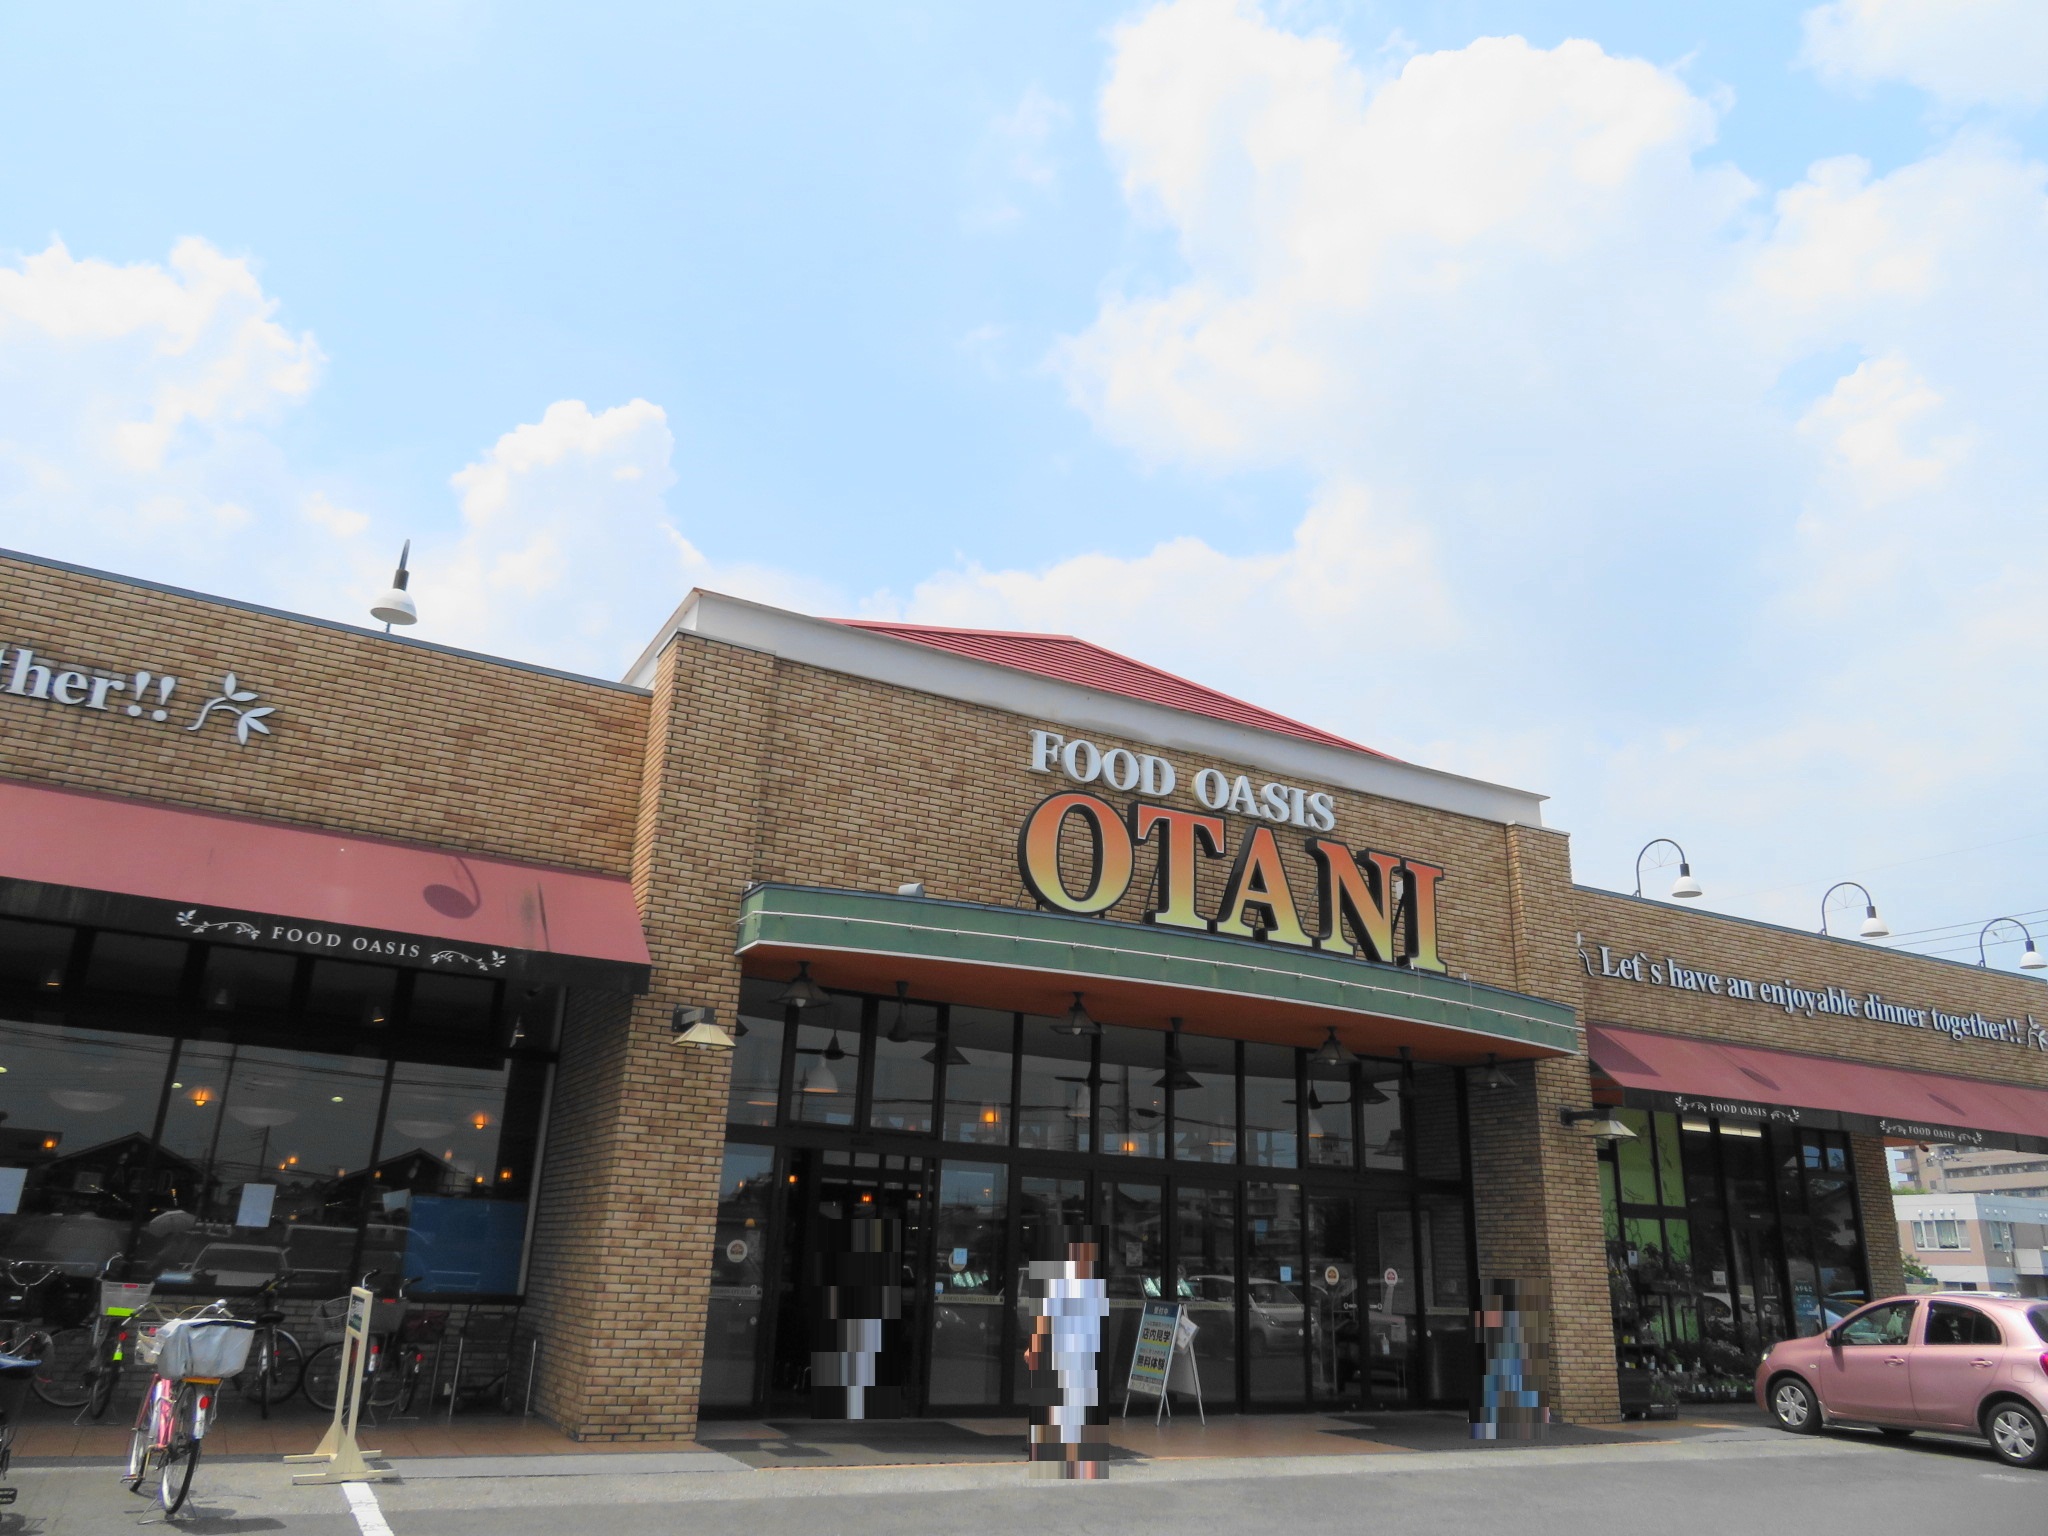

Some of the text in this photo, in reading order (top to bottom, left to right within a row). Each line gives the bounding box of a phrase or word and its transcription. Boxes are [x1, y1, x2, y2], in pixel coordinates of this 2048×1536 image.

[1028, 729, 1335, 832] FOOD OASIS
[1017, 790, 1447, 974] OTANI
[271, 926, 421, 958] FOOD OASIS
[1666, 957, 1721, 995] have
[1727, 976, 1754, 1001] an
[1759, 979, 1859, 1017] enjoyable
[1863, 993, 1926, 1029] dinner
[1930, 1007, 2022, 1043] together!!
[1710, 1102, 1767, 1117] FOOD OASIS
[1908, 1125, 1956, 1139] FOOD OASIS
[1143, 1327, 1171, 1343] 店内見学
[1136, 1354, 1166, 1370] 無料体験
